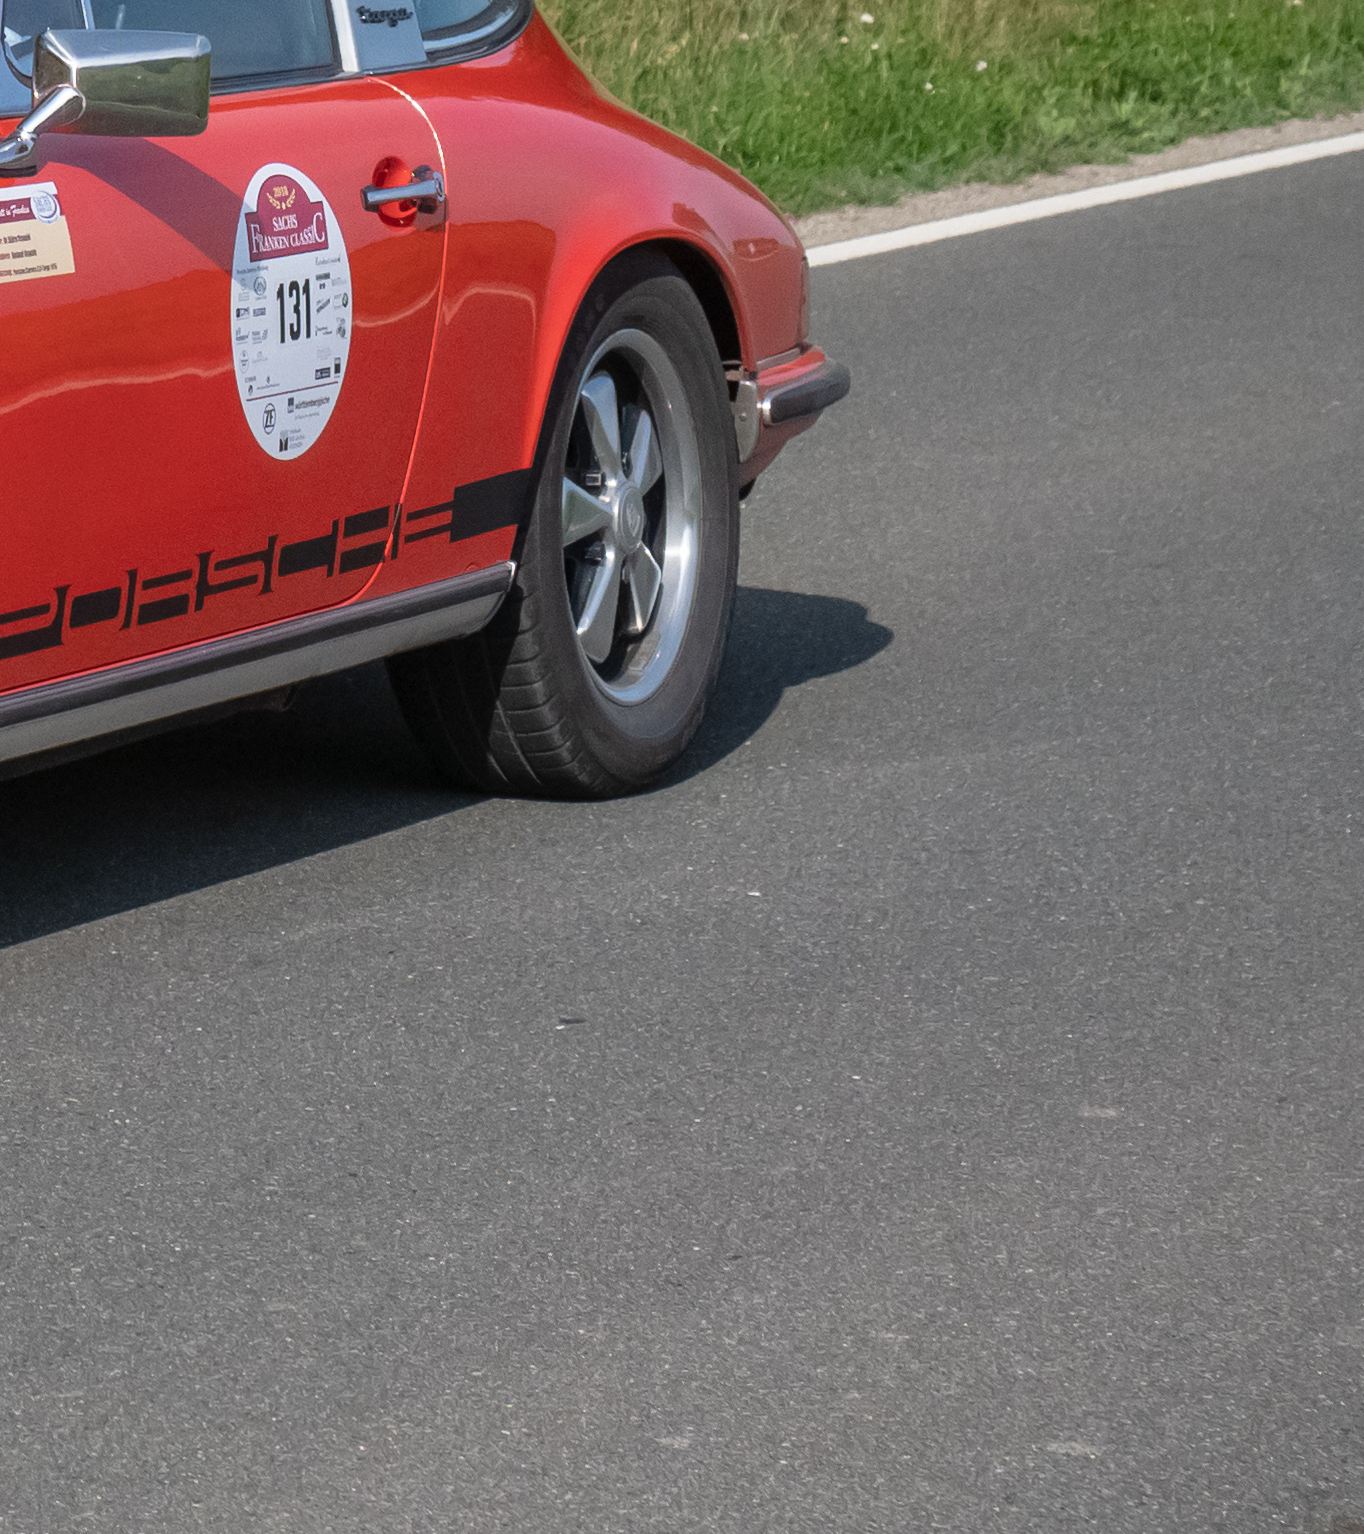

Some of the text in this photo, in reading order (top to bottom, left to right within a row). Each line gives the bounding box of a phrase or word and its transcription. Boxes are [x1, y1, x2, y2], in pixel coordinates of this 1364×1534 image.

[250, 211, 325, 253] FRANKEN CLASSIC
[272, 213, 298, 232] SACHS
[276, 278, 312, 344] 131
[263, 408, 275, 429] ZF
